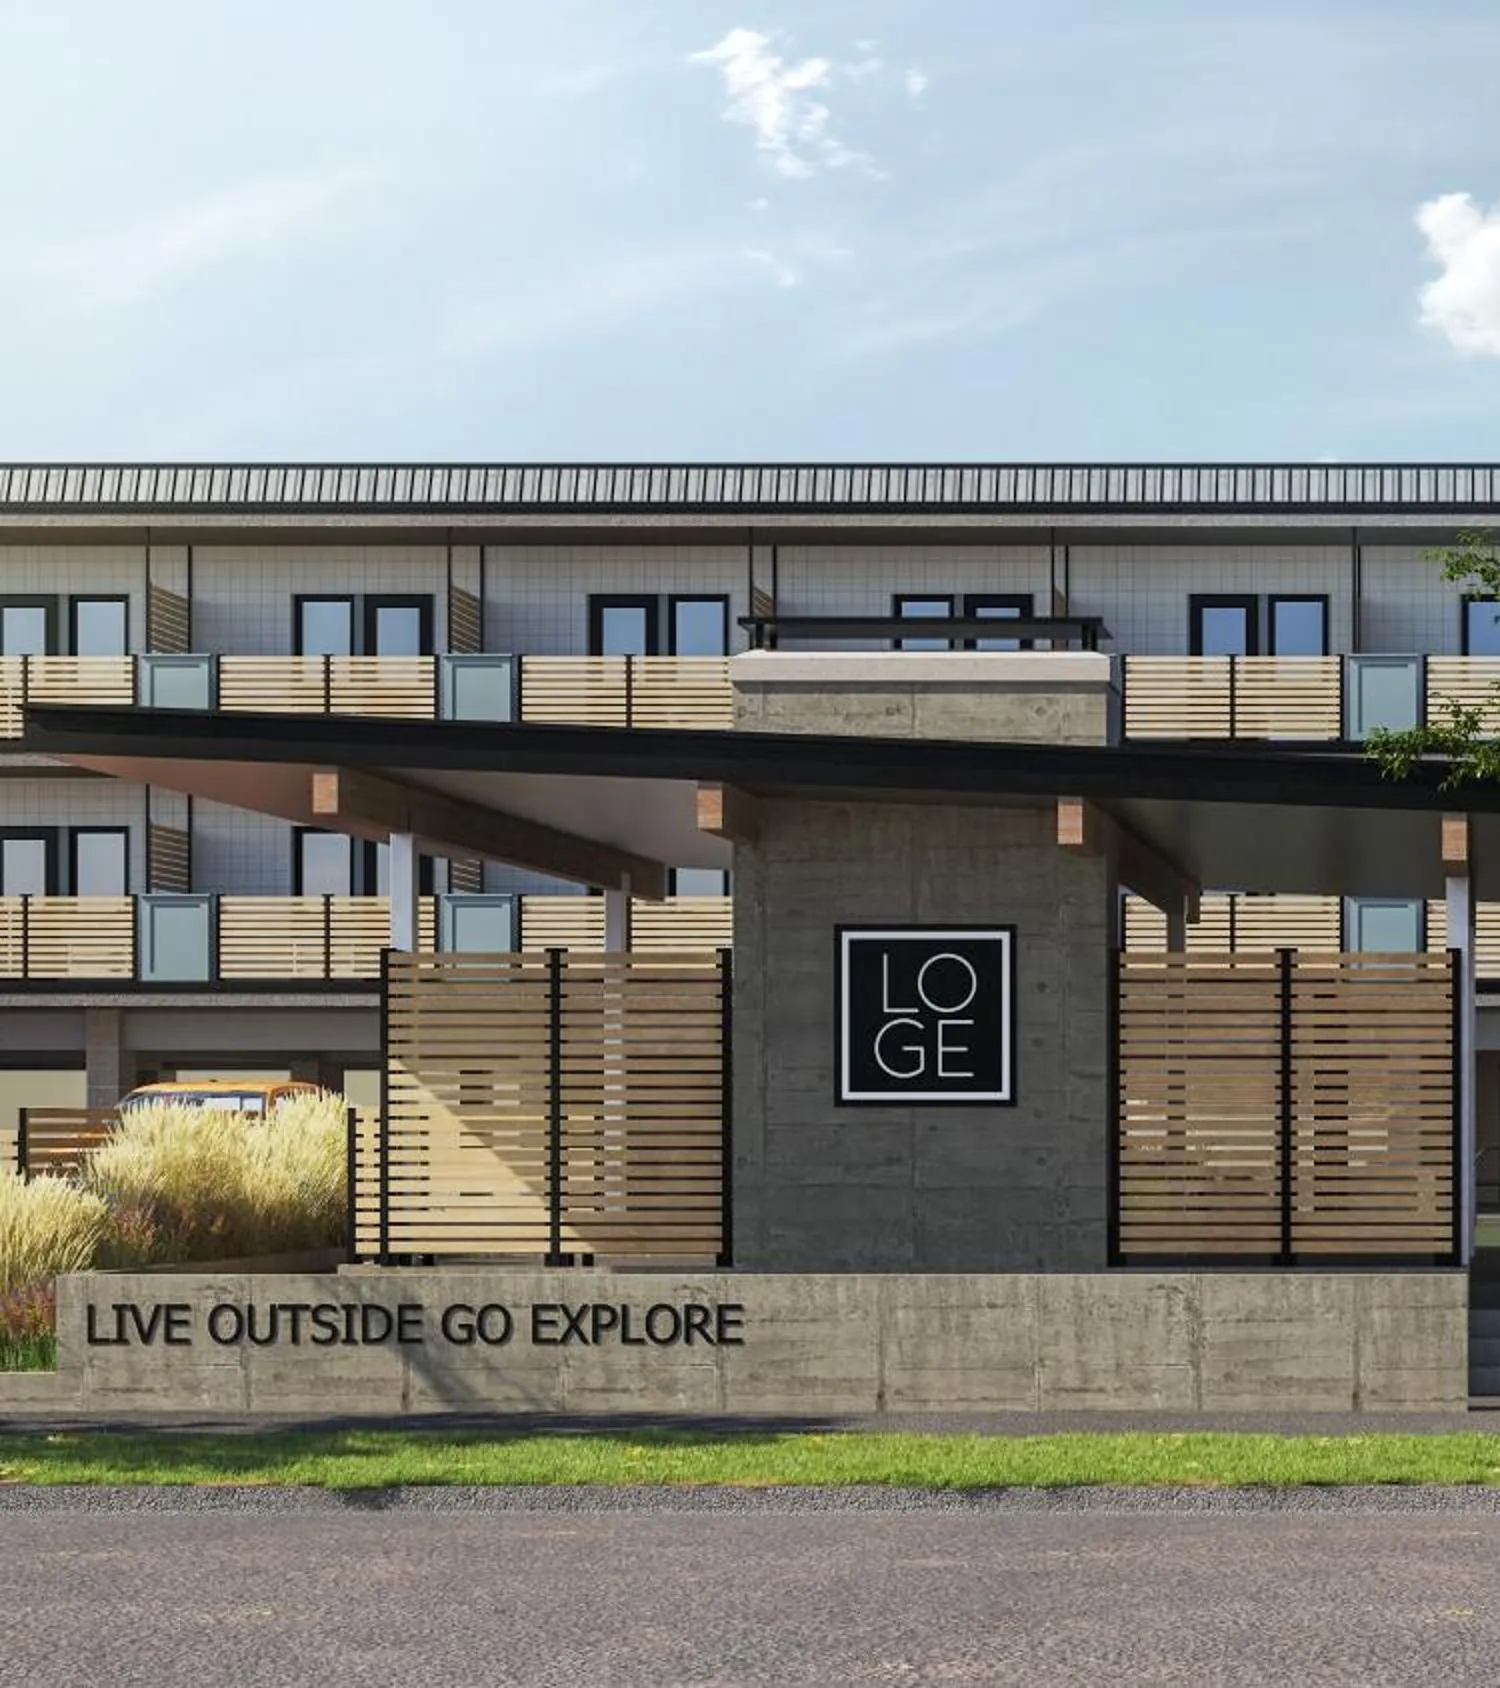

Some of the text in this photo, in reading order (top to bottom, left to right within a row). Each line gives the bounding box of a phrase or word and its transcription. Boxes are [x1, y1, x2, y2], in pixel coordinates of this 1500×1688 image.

[86, 1302, 747, 1348] LIVE OUTSIDE GO EXPLORE
